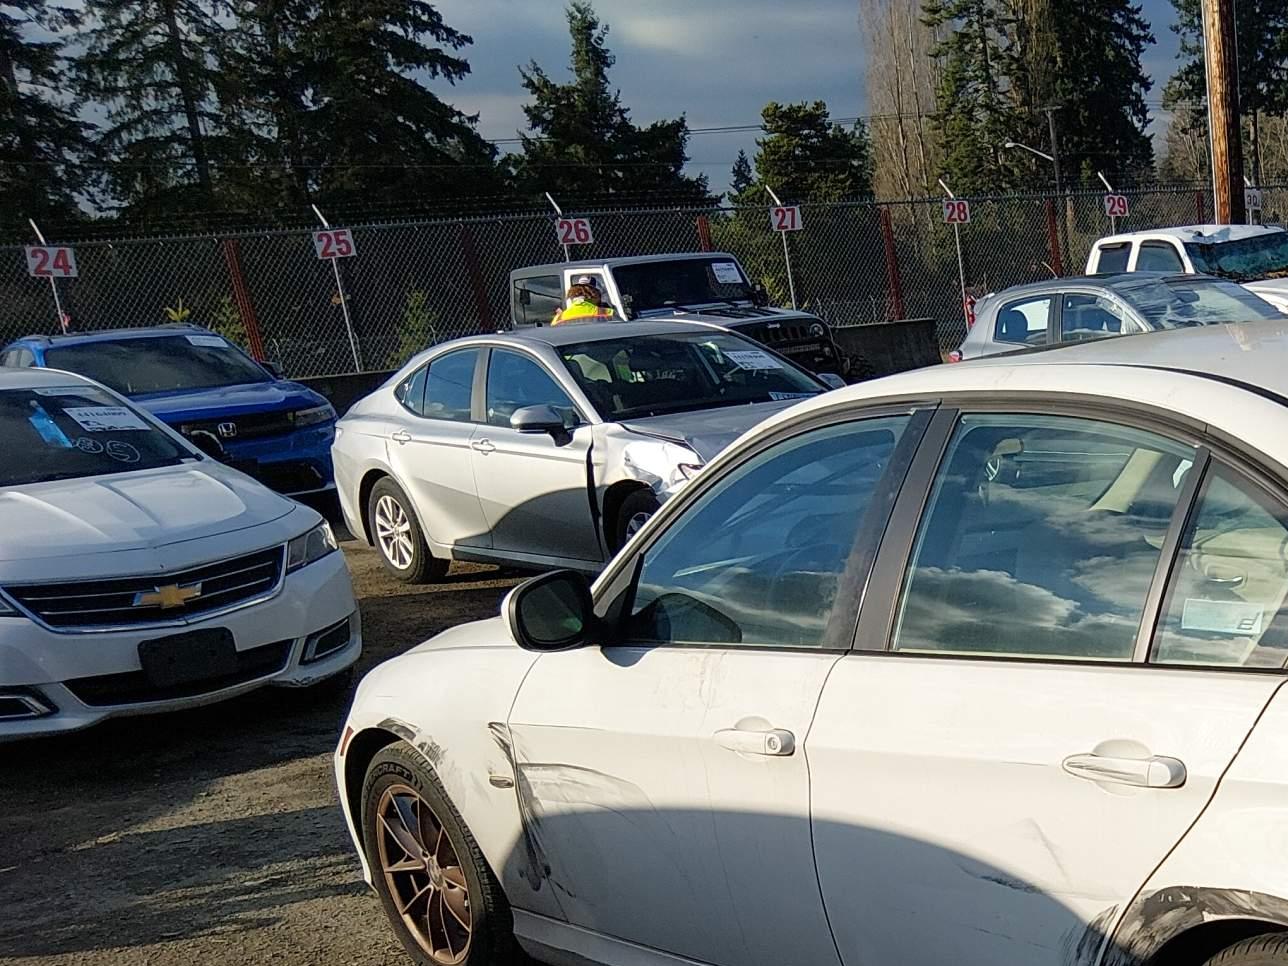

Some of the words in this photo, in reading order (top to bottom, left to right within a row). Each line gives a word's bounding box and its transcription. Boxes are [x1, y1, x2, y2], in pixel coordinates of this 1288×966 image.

[945, 201, 968, 222] 28
[1107, 196, 1127, 215] 29
[774, 207, 796, 230] 27
[559, 220, 590, 243] 26
[317, 230, 352, 257] 25
[31, 248, 73, 275] 24
